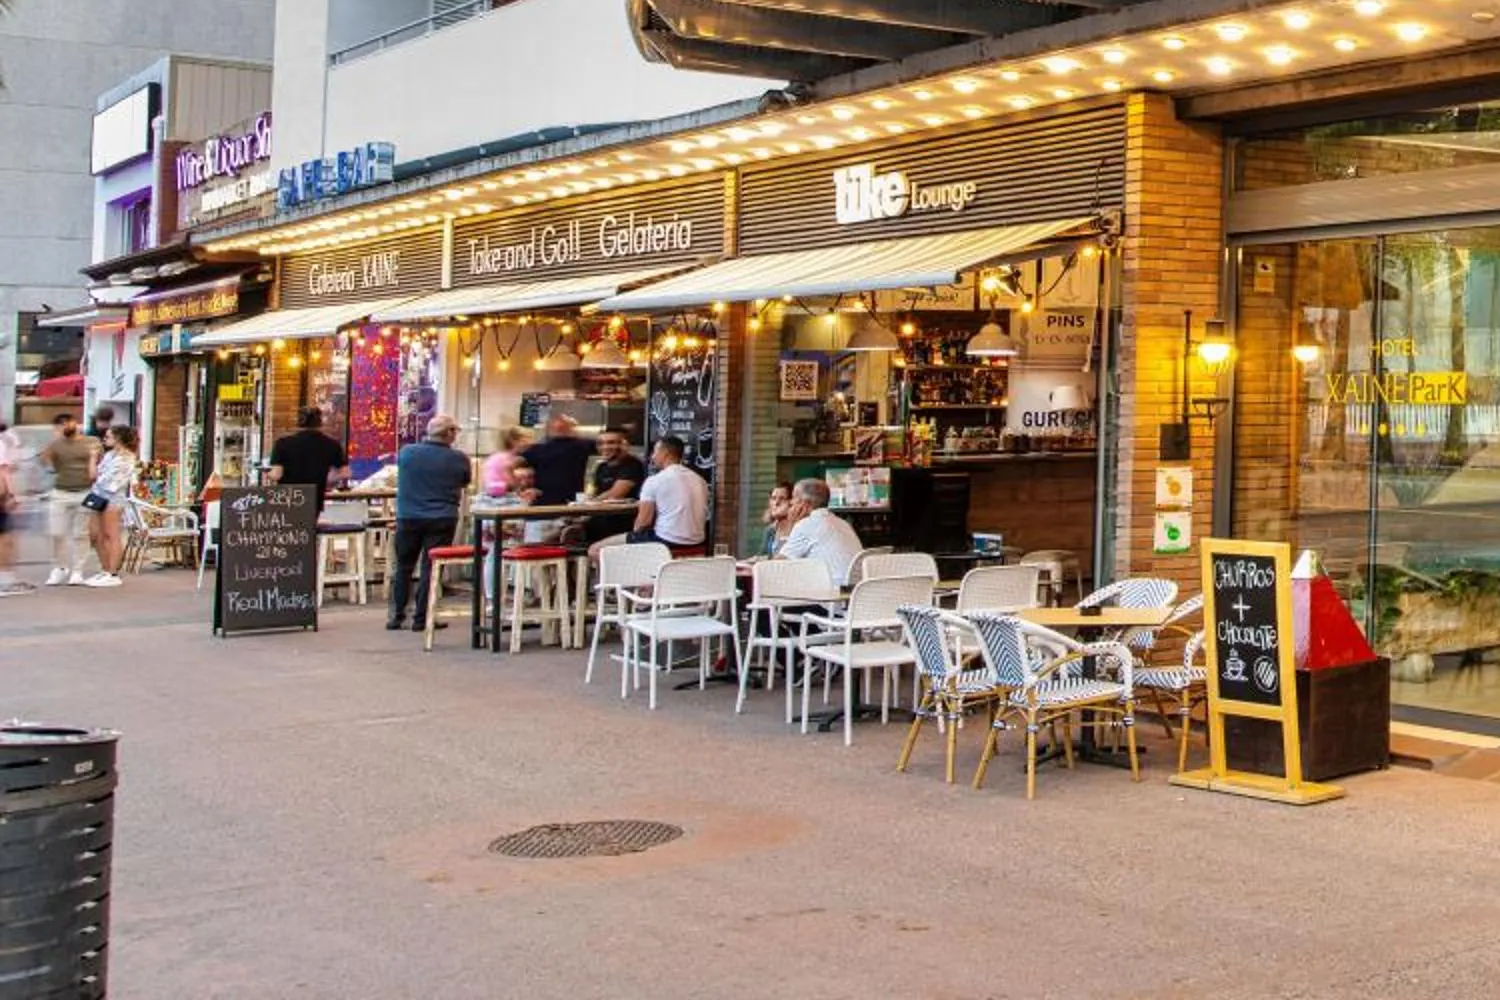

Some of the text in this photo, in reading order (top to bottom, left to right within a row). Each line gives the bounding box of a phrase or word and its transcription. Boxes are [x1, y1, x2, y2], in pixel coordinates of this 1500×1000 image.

[911, 181, 977, 212] Lounge
[468, 236, 501, 275] Take
[505, 228, 535, 271] and
[598, 211, 692, 258] Gelateria
[1046, 314, 1085, 329] PINS
[1369, 337, 1419, 357] HOTEL
[1326, 372, 1407, 404] XAINE
[237, 511, 293, 529] FINAL
[1215, 559, 1275, 589] CHURROS
